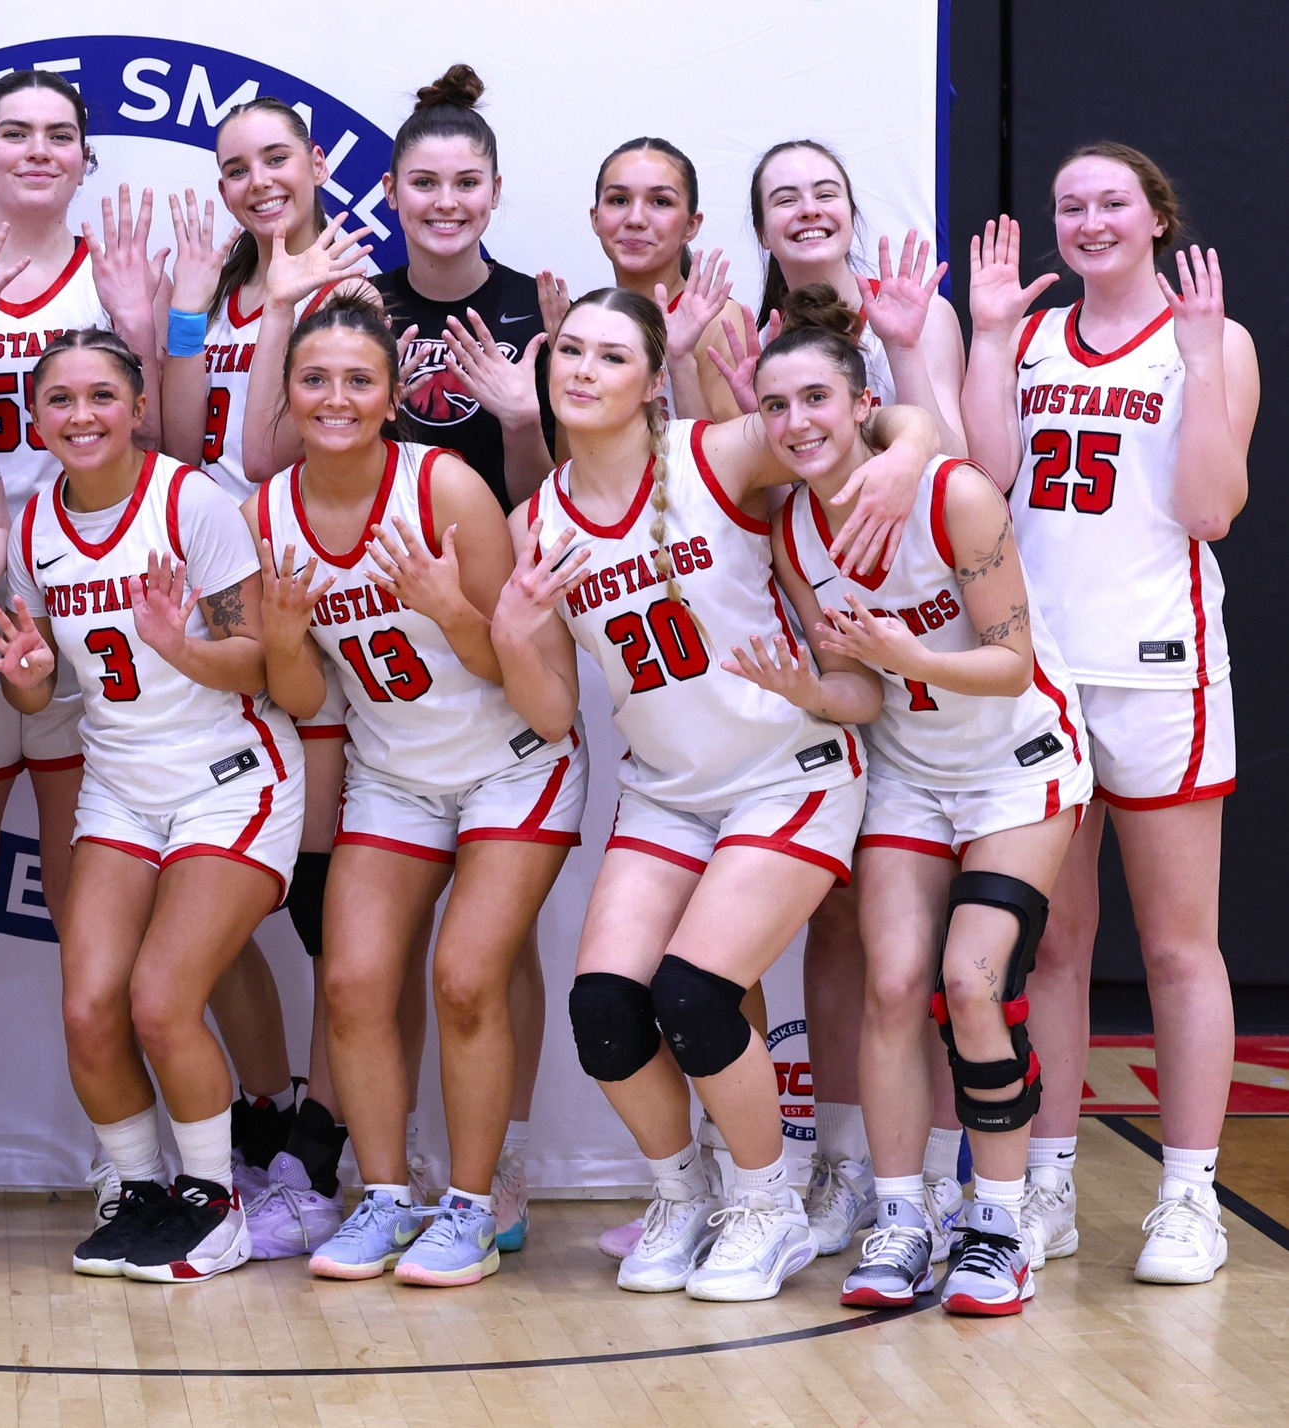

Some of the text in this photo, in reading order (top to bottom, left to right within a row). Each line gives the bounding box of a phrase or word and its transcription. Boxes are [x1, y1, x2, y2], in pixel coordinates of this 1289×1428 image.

[117, 57, 392, 242] SMLL
[1021, 384, 1164, 425] MUSTANGS
[1028, 428, 1122, 516] 25
[84, 626, 142, 703] 3
[338, 626, 434, 703] 13
[604, 597, 711, 695] 20
[767, 1022, 805, 1050] ANKEE
[784, 1107, 805, 1115] EST.
